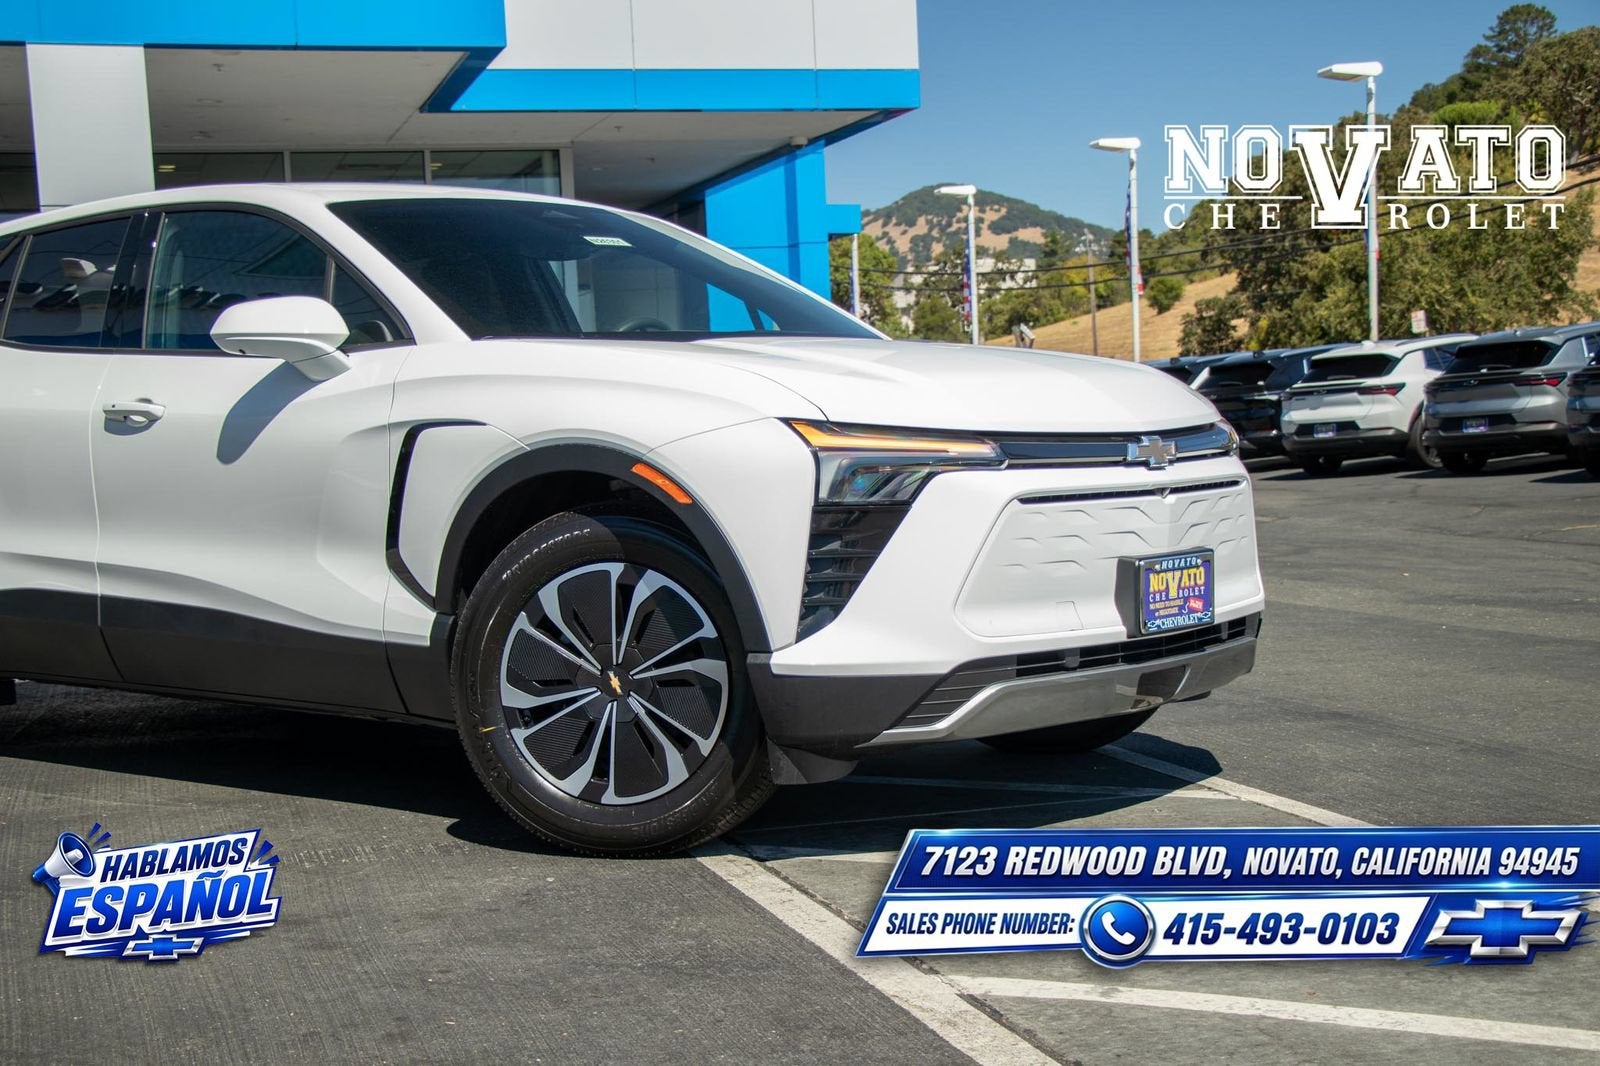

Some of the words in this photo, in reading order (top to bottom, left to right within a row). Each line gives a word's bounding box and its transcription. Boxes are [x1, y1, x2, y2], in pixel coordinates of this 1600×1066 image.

[1162, 557, 1196, 569] NOVATO
[1150, 567, 1204, 598] NOVATO
[1160, 613, 1198, 628] CHEVROLET
